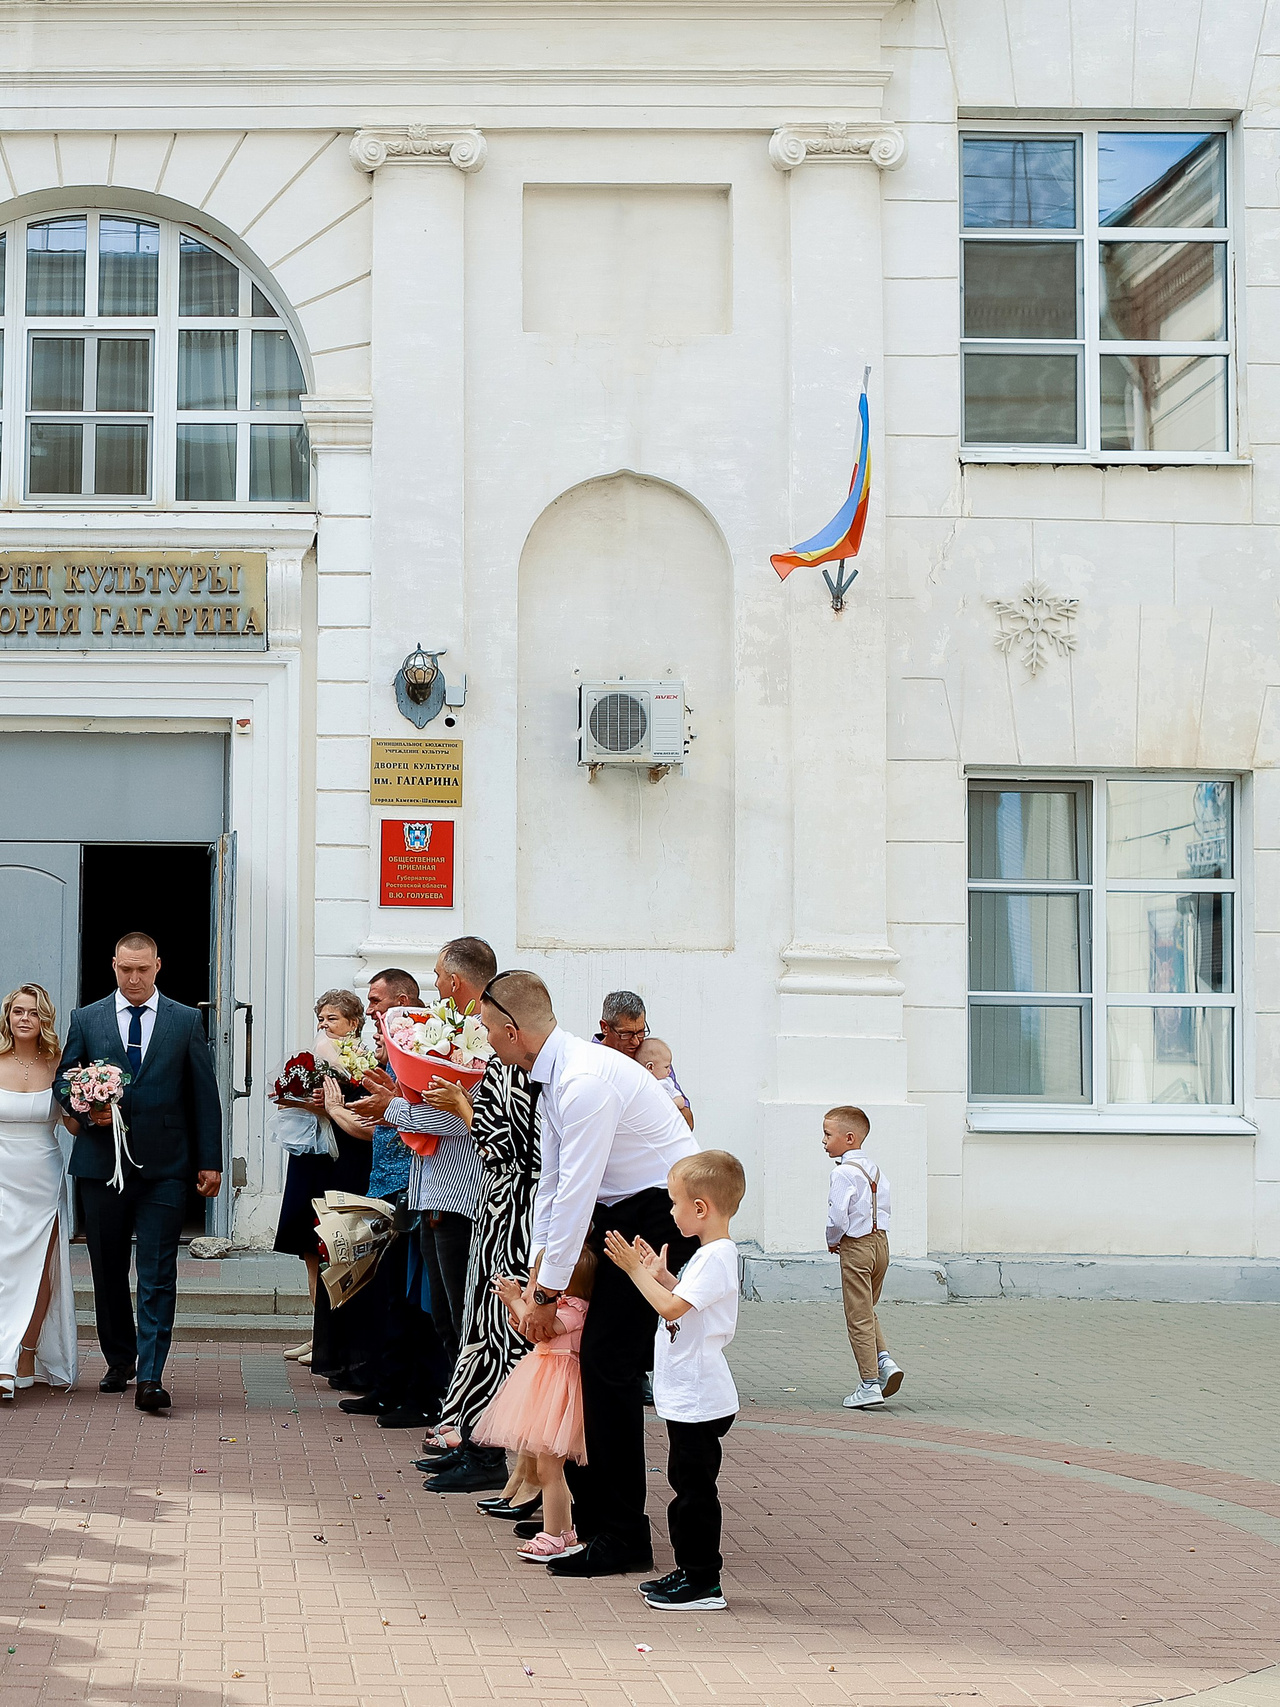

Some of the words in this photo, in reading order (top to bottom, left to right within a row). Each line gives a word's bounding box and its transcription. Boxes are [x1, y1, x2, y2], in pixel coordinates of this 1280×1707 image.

[63, 563, 242, 595] КУЛЬТУРЫ
[92, 605, 264, 636] ГАГАРИНА
[373, 762, 410, 771] ДВОРЕЦ
[413, 762, 460, 771] КУЛЬТУРЫ
[396, 775, 460, 787] ГАГАРИНА
[396, 874, 437, 882] Губернатора
